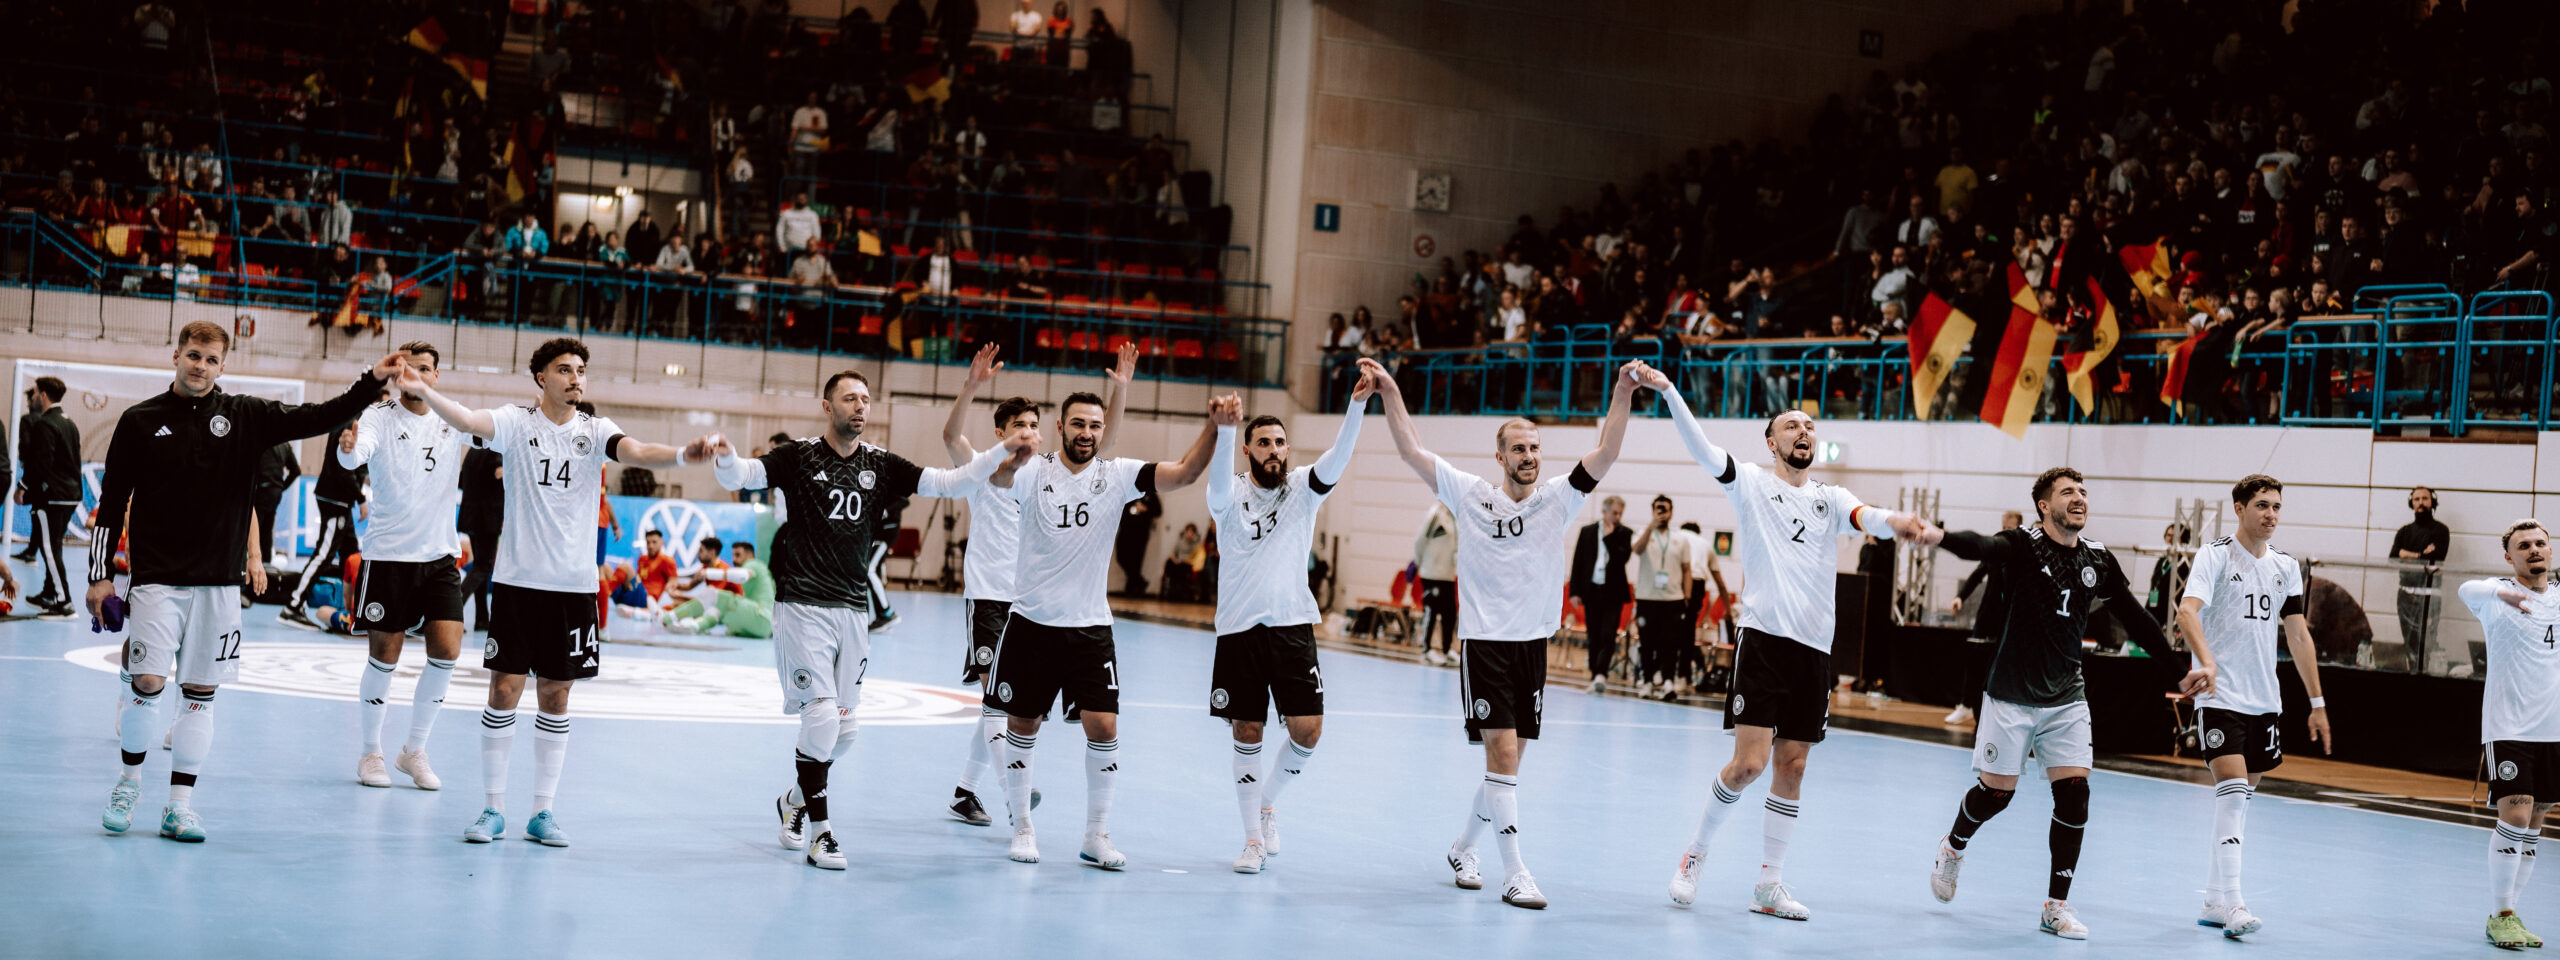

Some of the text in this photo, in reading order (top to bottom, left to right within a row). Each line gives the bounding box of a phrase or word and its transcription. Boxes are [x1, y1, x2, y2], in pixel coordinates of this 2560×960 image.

[422, 447, 436, 472] 3
[538, 458, 571, 488] 14
[828, 489, 862, 521] 20
[1057, 502, 1089, 528] 16
[1251, 510, 1277, 540] 13
[1492, 516, 1524, 538] 10
[1791, 518, 1806, 543] 2
[2056, 588, 2071, 617] 1
[2244, 594, 2271, 621] 19
[215, 630, 241, 661] 12
[569, 623, 598, 656] 14
[2543, 624, 2555, 649] 4
[2265, 724, 2280, 751] 1
